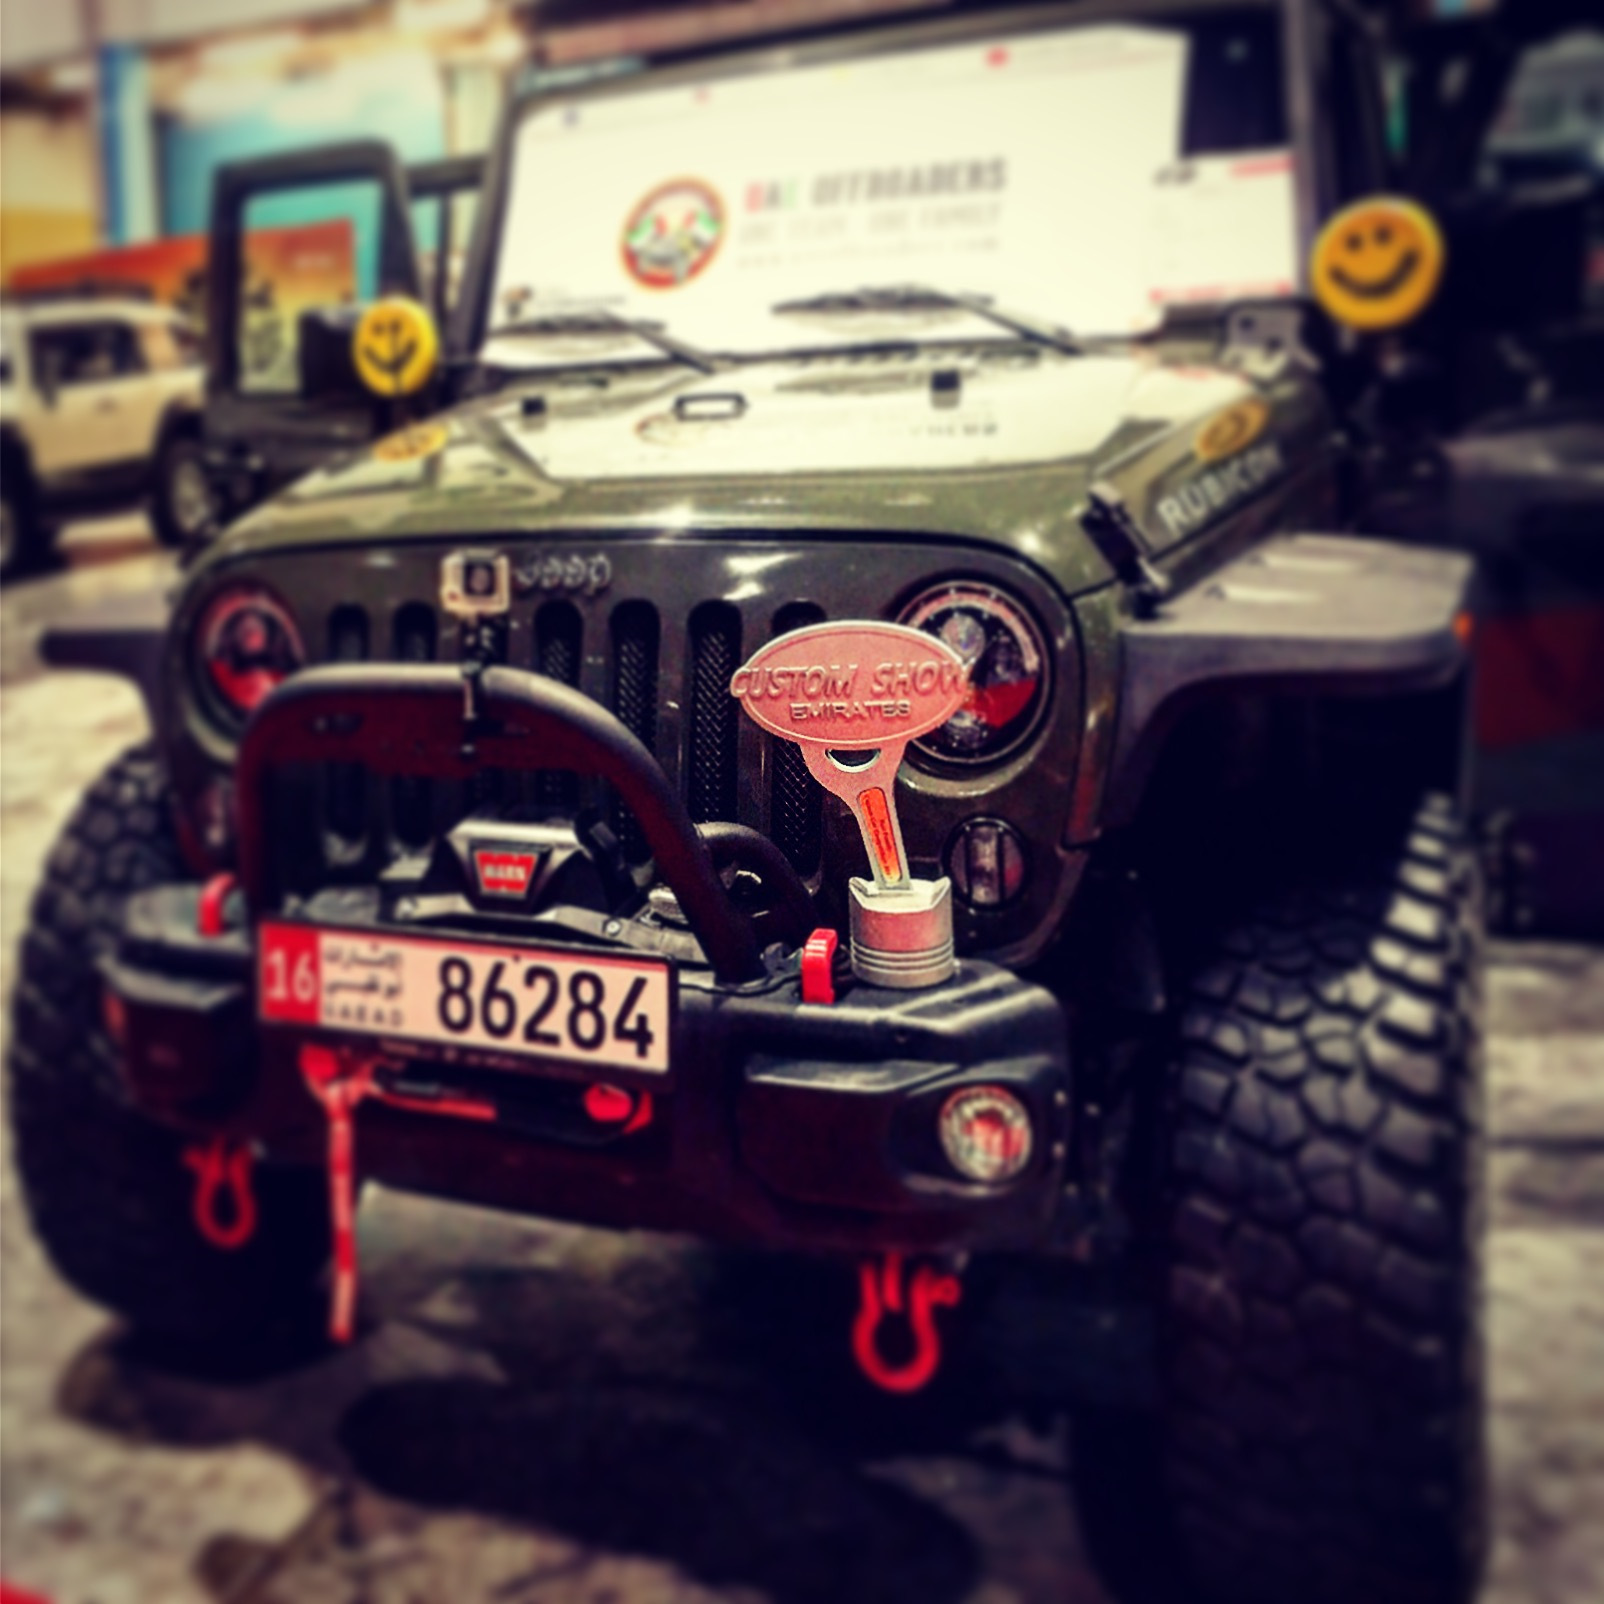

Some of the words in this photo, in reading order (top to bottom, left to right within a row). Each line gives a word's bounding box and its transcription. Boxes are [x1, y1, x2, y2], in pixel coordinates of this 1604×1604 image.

[1156, 443, 1282, 539] RUBICON
[731, 664, 859, 700] CUSTOM
[789, 699, 913, 721] EMIRATES
[267, 948, 317, 1005] 16
[437, 955, 655, 1060] 86284
